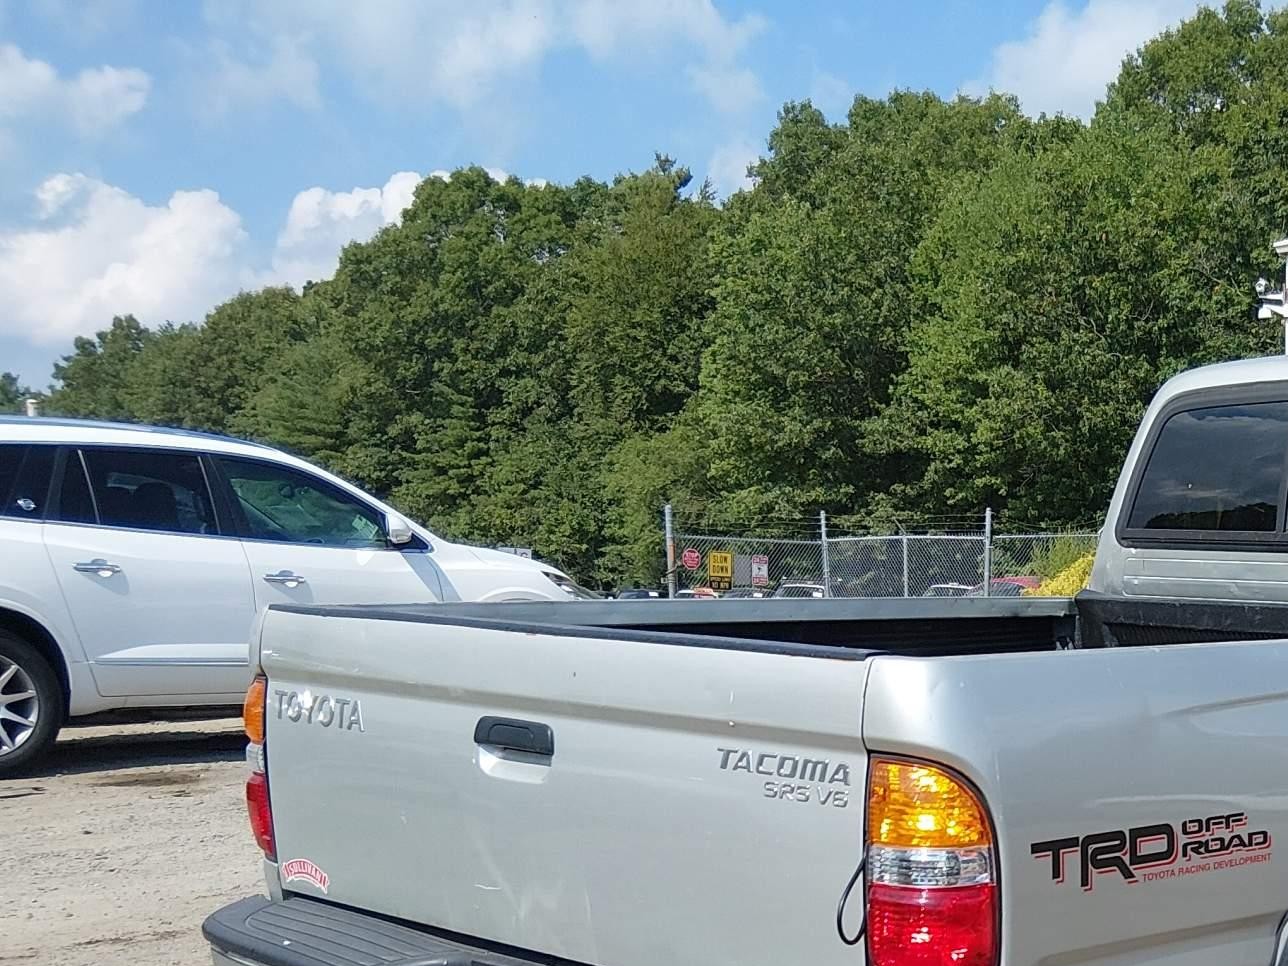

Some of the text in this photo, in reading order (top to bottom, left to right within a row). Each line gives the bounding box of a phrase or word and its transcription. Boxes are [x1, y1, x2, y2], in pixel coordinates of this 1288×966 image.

[712, 554, 728, 565] SLOW
[712, 564, 729, 574] DOWN
[274, 689, 366, 733] TOYOTA
[717, 747, 851, 787] TACOMA
[817, 785, 849, 809] V6
[1181, 812, 1249, 839] OFF
[1030, 822, 1178, 892] TRD
[1181, 830, 1271, 862] ROAD
[1142, 852, 1273, 883] TOYOTA RACING DEVELOPMENT
